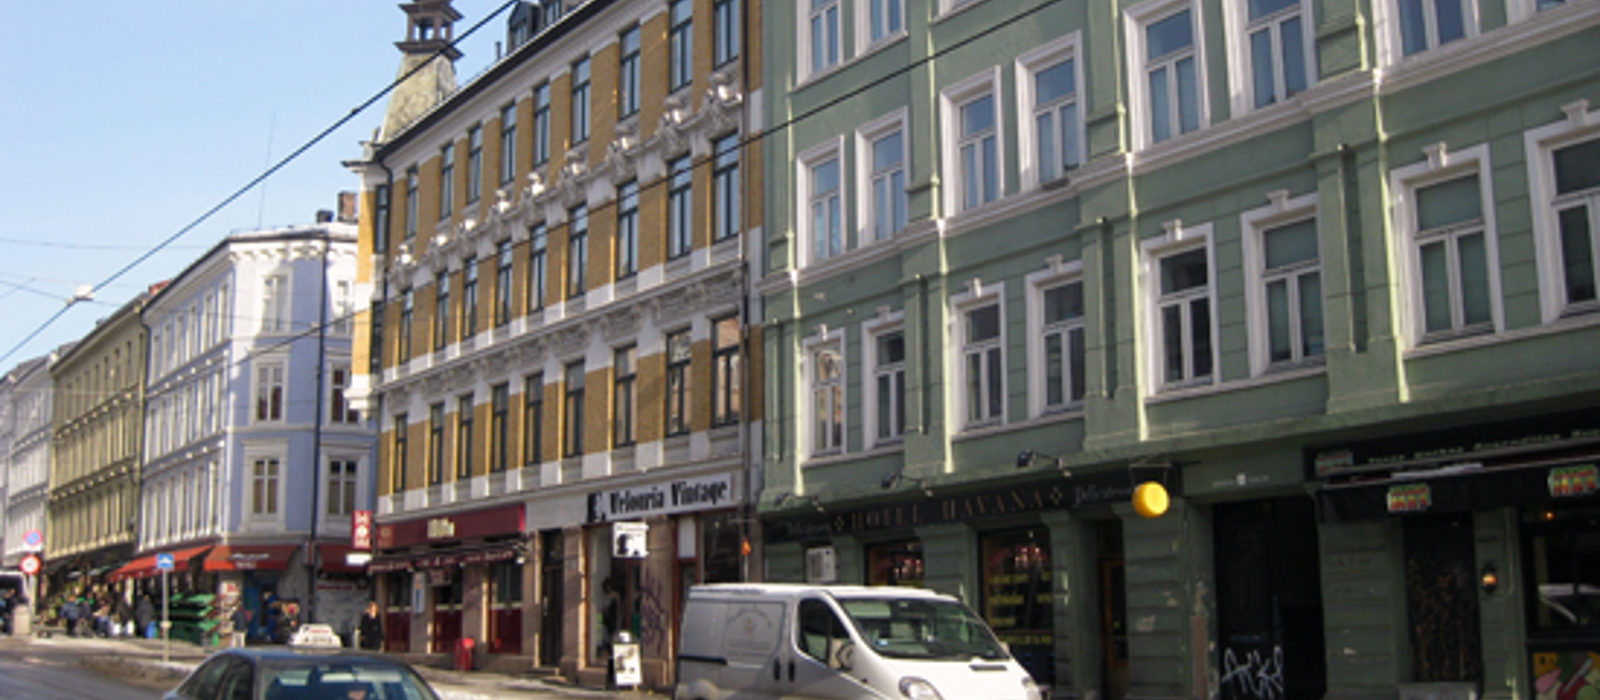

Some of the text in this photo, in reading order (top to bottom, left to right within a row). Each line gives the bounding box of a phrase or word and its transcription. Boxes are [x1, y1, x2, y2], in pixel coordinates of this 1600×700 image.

[610, 481, 727, 514] Velouria Vintage
[850, 503, 924, 530] HOTEL
[942, 489, 1045, 521] HAVANA
